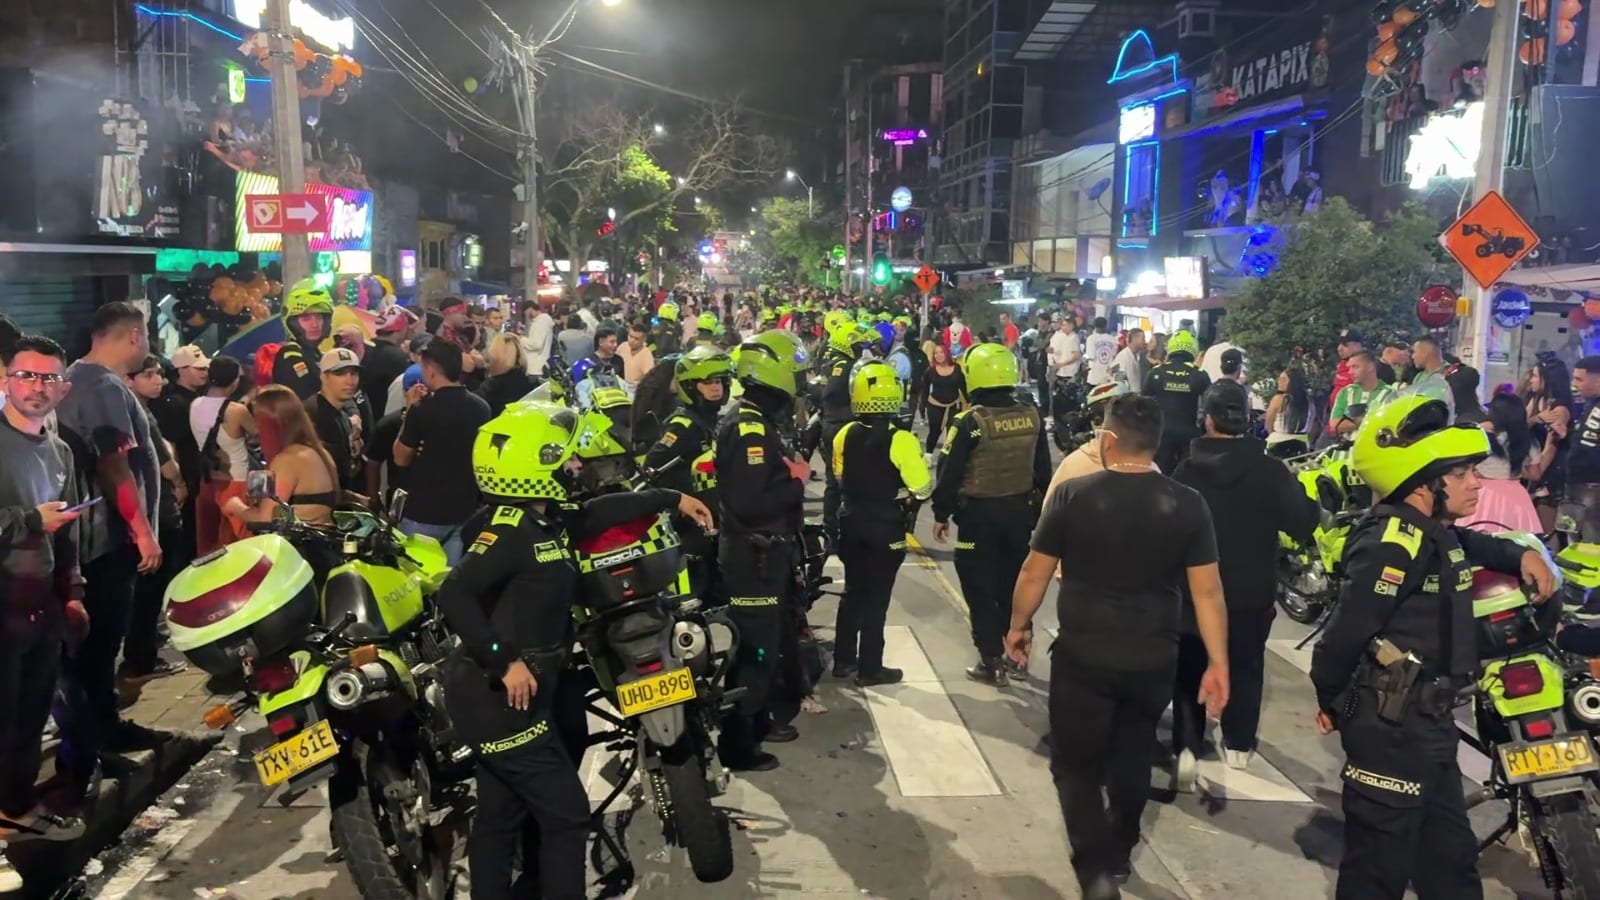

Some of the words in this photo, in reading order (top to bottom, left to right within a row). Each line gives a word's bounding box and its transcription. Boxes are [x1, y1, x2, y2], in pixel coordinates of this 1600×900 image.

[1232, 41, 1311, 99] KATAPIX
[621, 684, 654, 707] UHD
[659, 674, 690, 697] 89G
[258, 746, 290, 778] TXV
[299, 728, 333, 759] 61E
[1506, 746, 1543, 773] RTY
